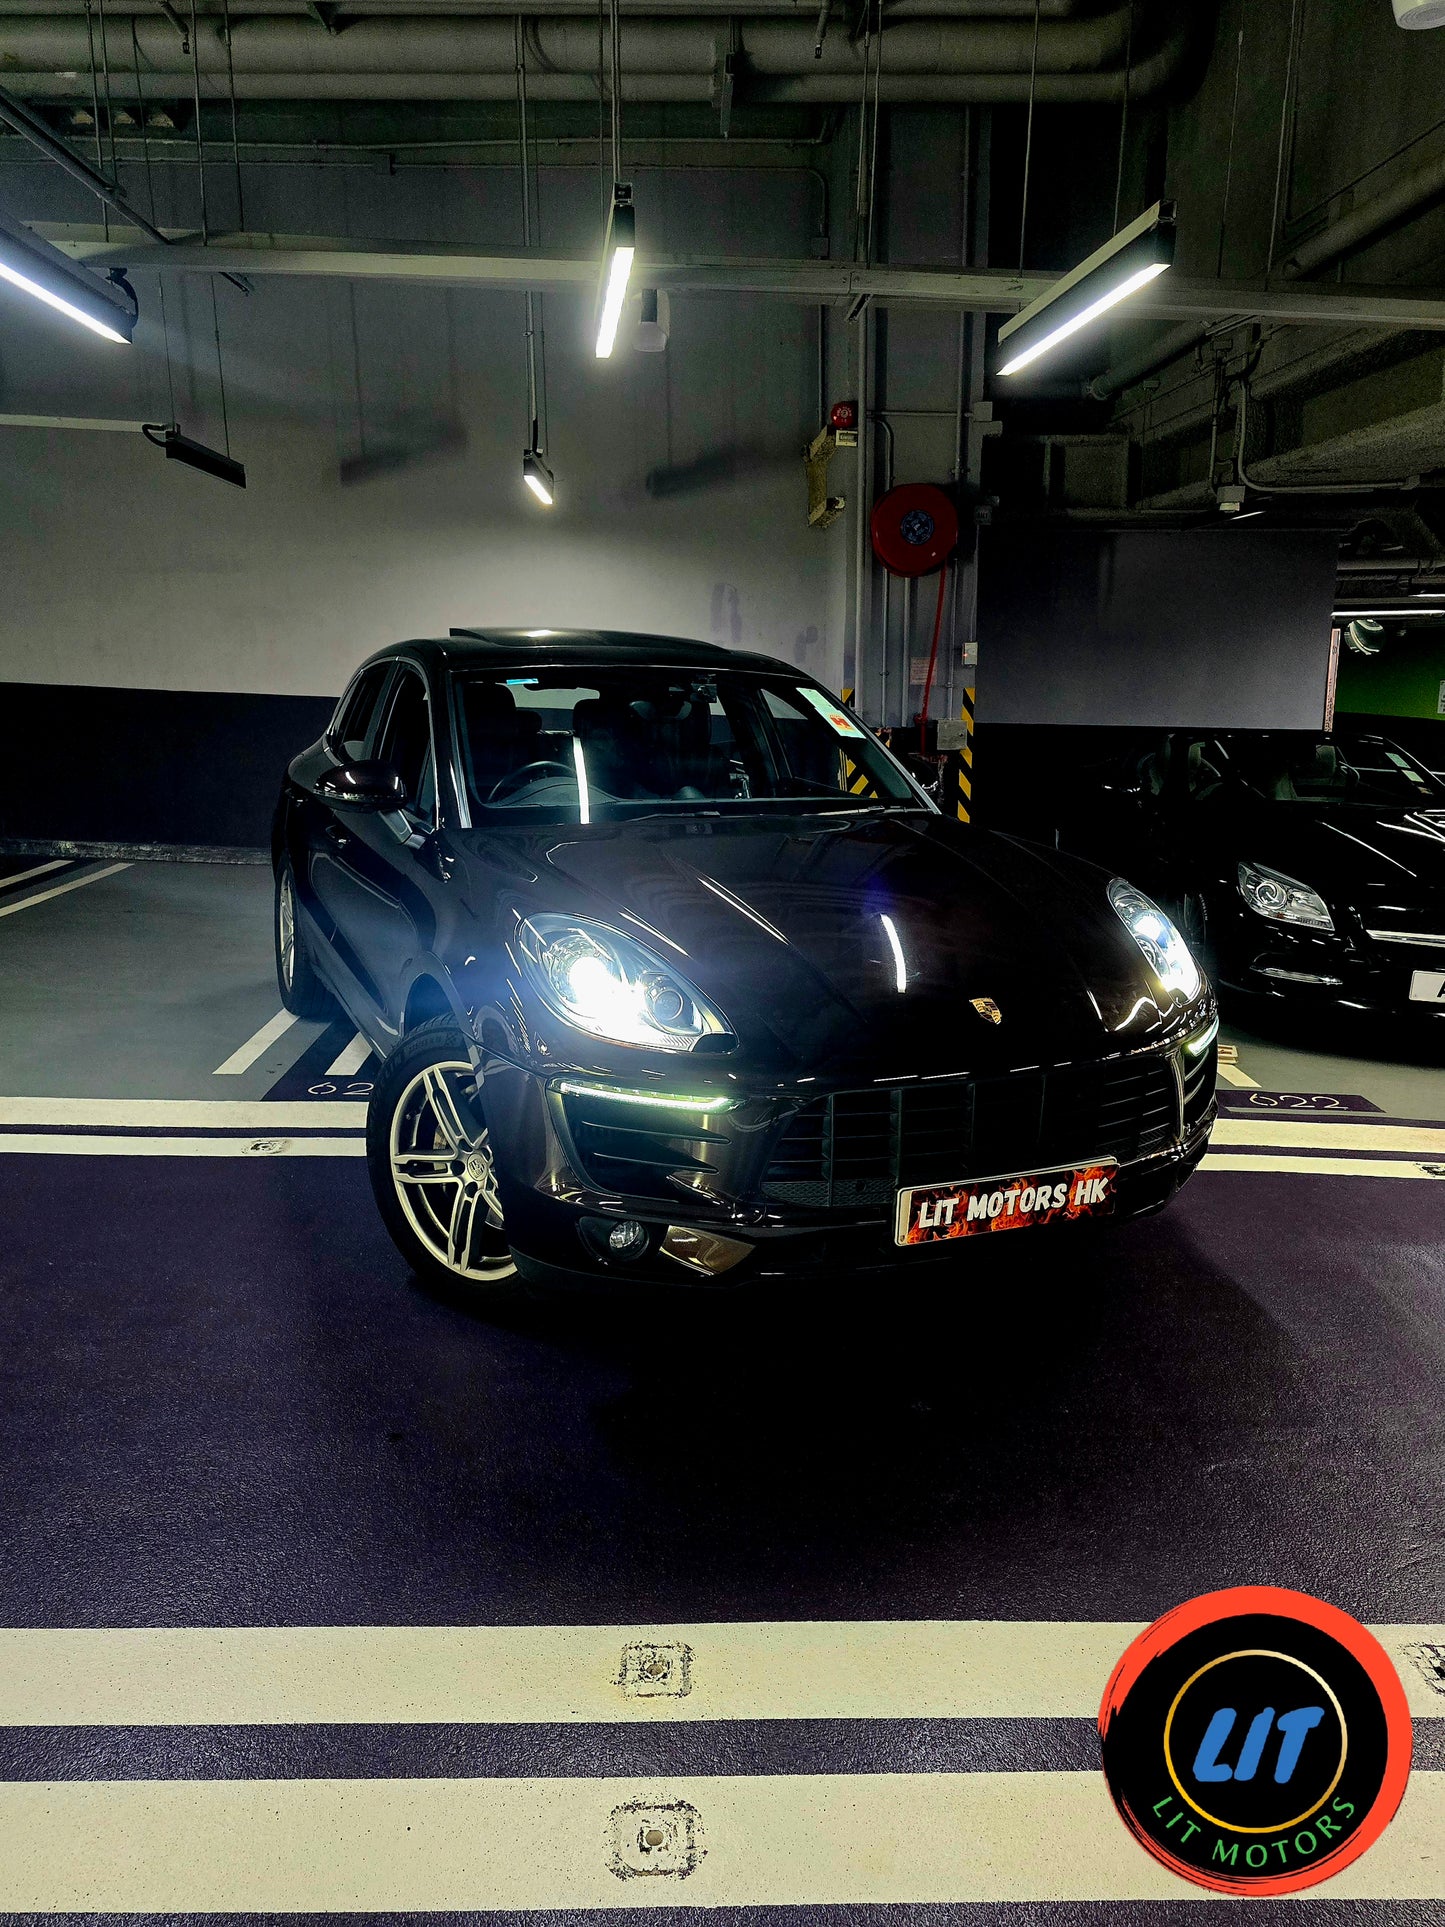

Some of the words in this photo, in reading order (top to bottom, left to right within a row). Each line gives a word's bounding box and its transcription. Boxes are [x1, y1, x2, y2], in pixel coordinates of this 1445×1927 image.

[1249, 1093, 1349, 1110] 622
[918, 1198, 960, 1229] LIT
[966, 1182, 1068, 1221] MOTORS
[1073, 1176, 1109, 1206] HK
